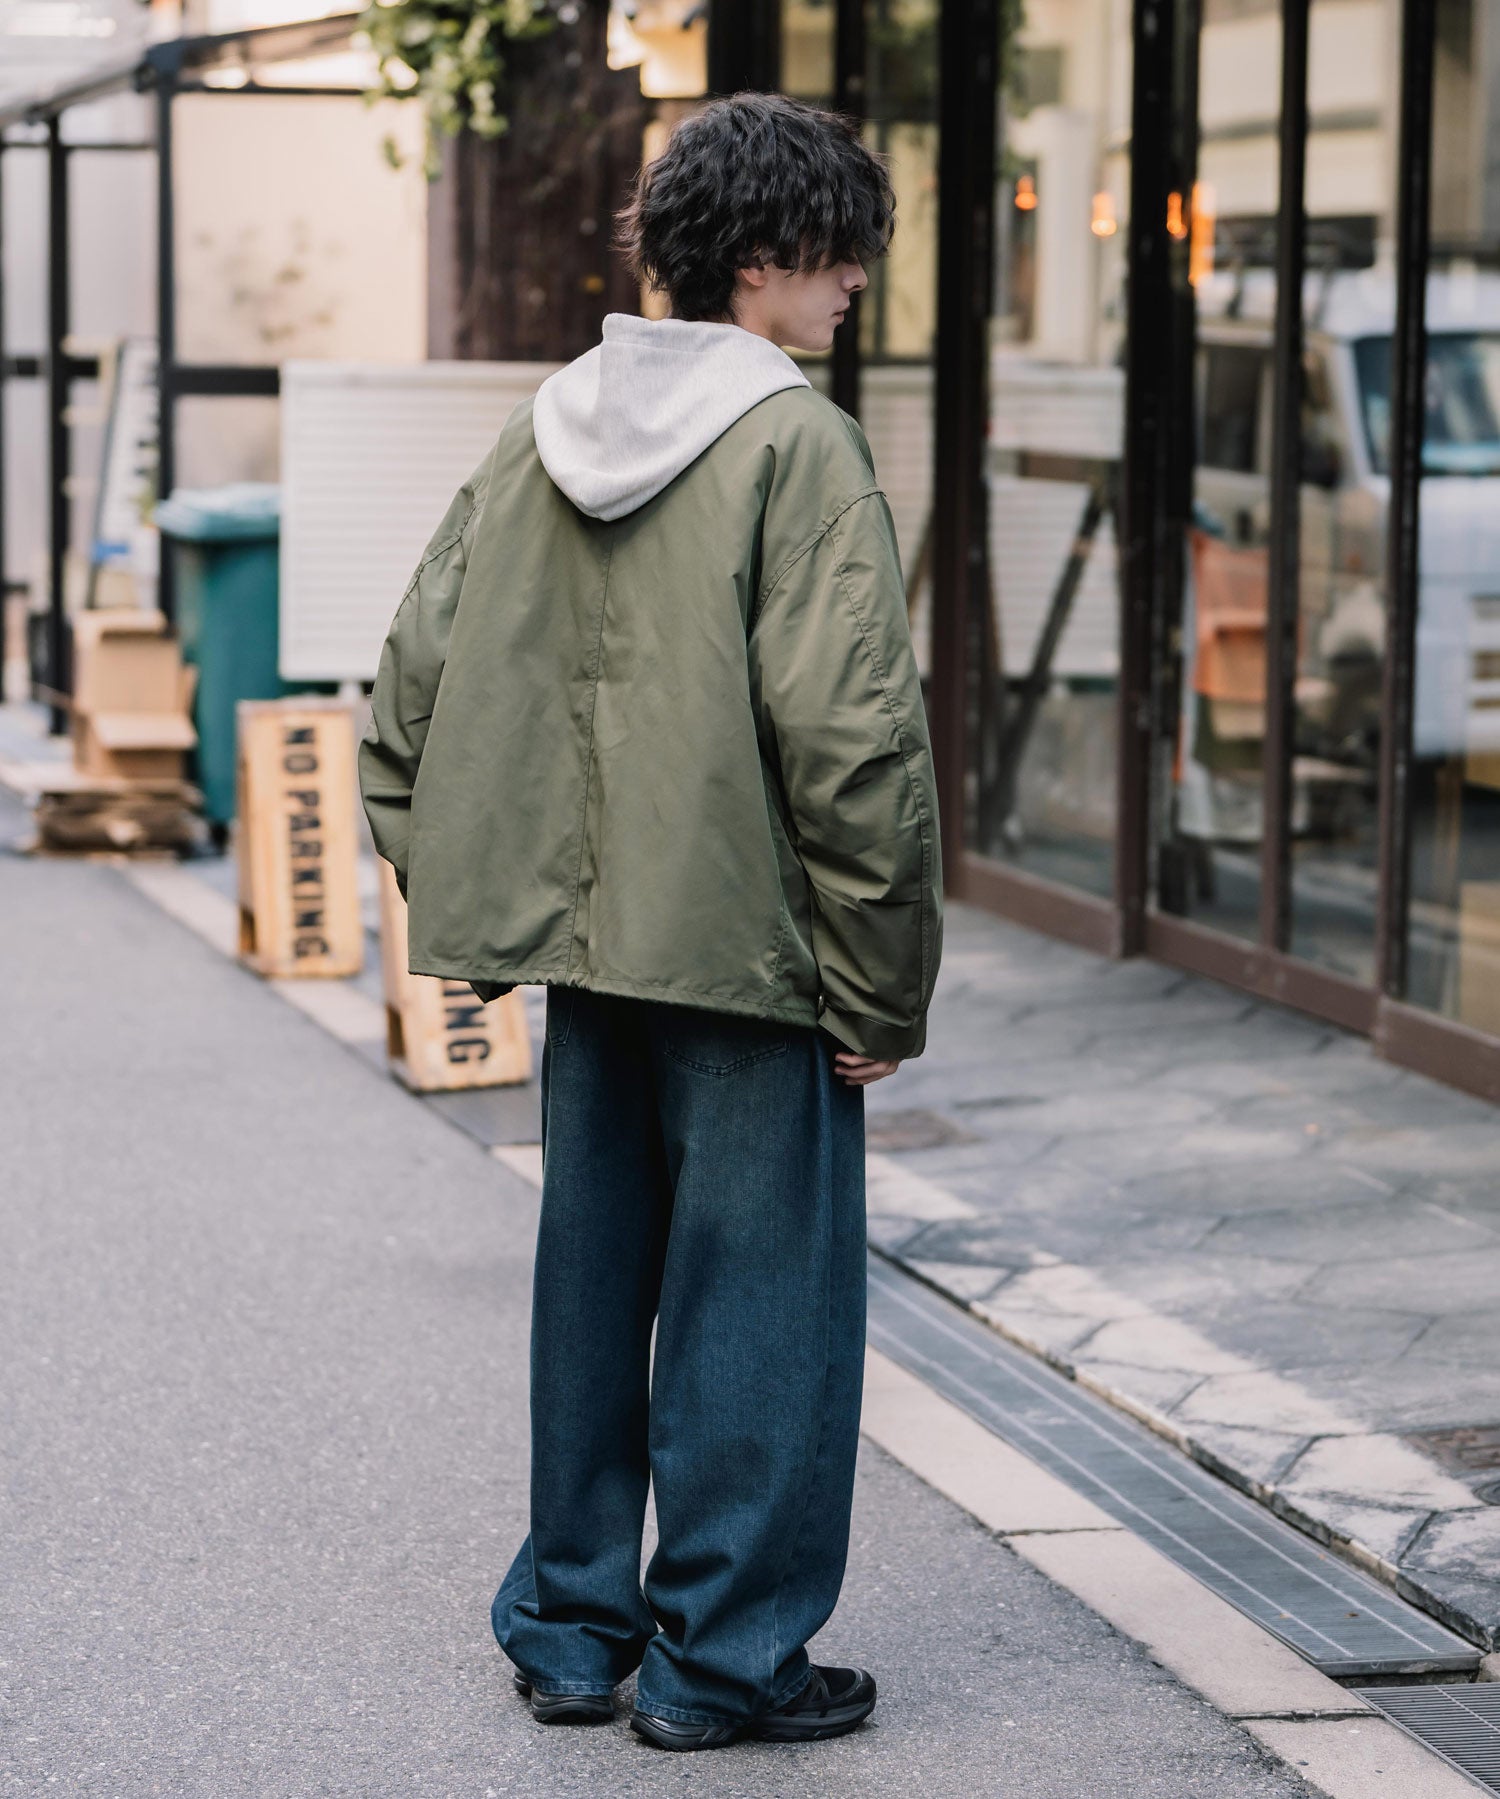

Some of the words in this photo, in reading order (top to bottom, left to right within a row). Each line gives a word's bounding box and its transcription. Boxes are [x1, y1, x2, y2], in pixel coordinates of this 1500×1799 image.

[284, 727, 319, 774] NO
[287, 790, 329, 957] PARKING
[443, 988, 490, 1063] ING
